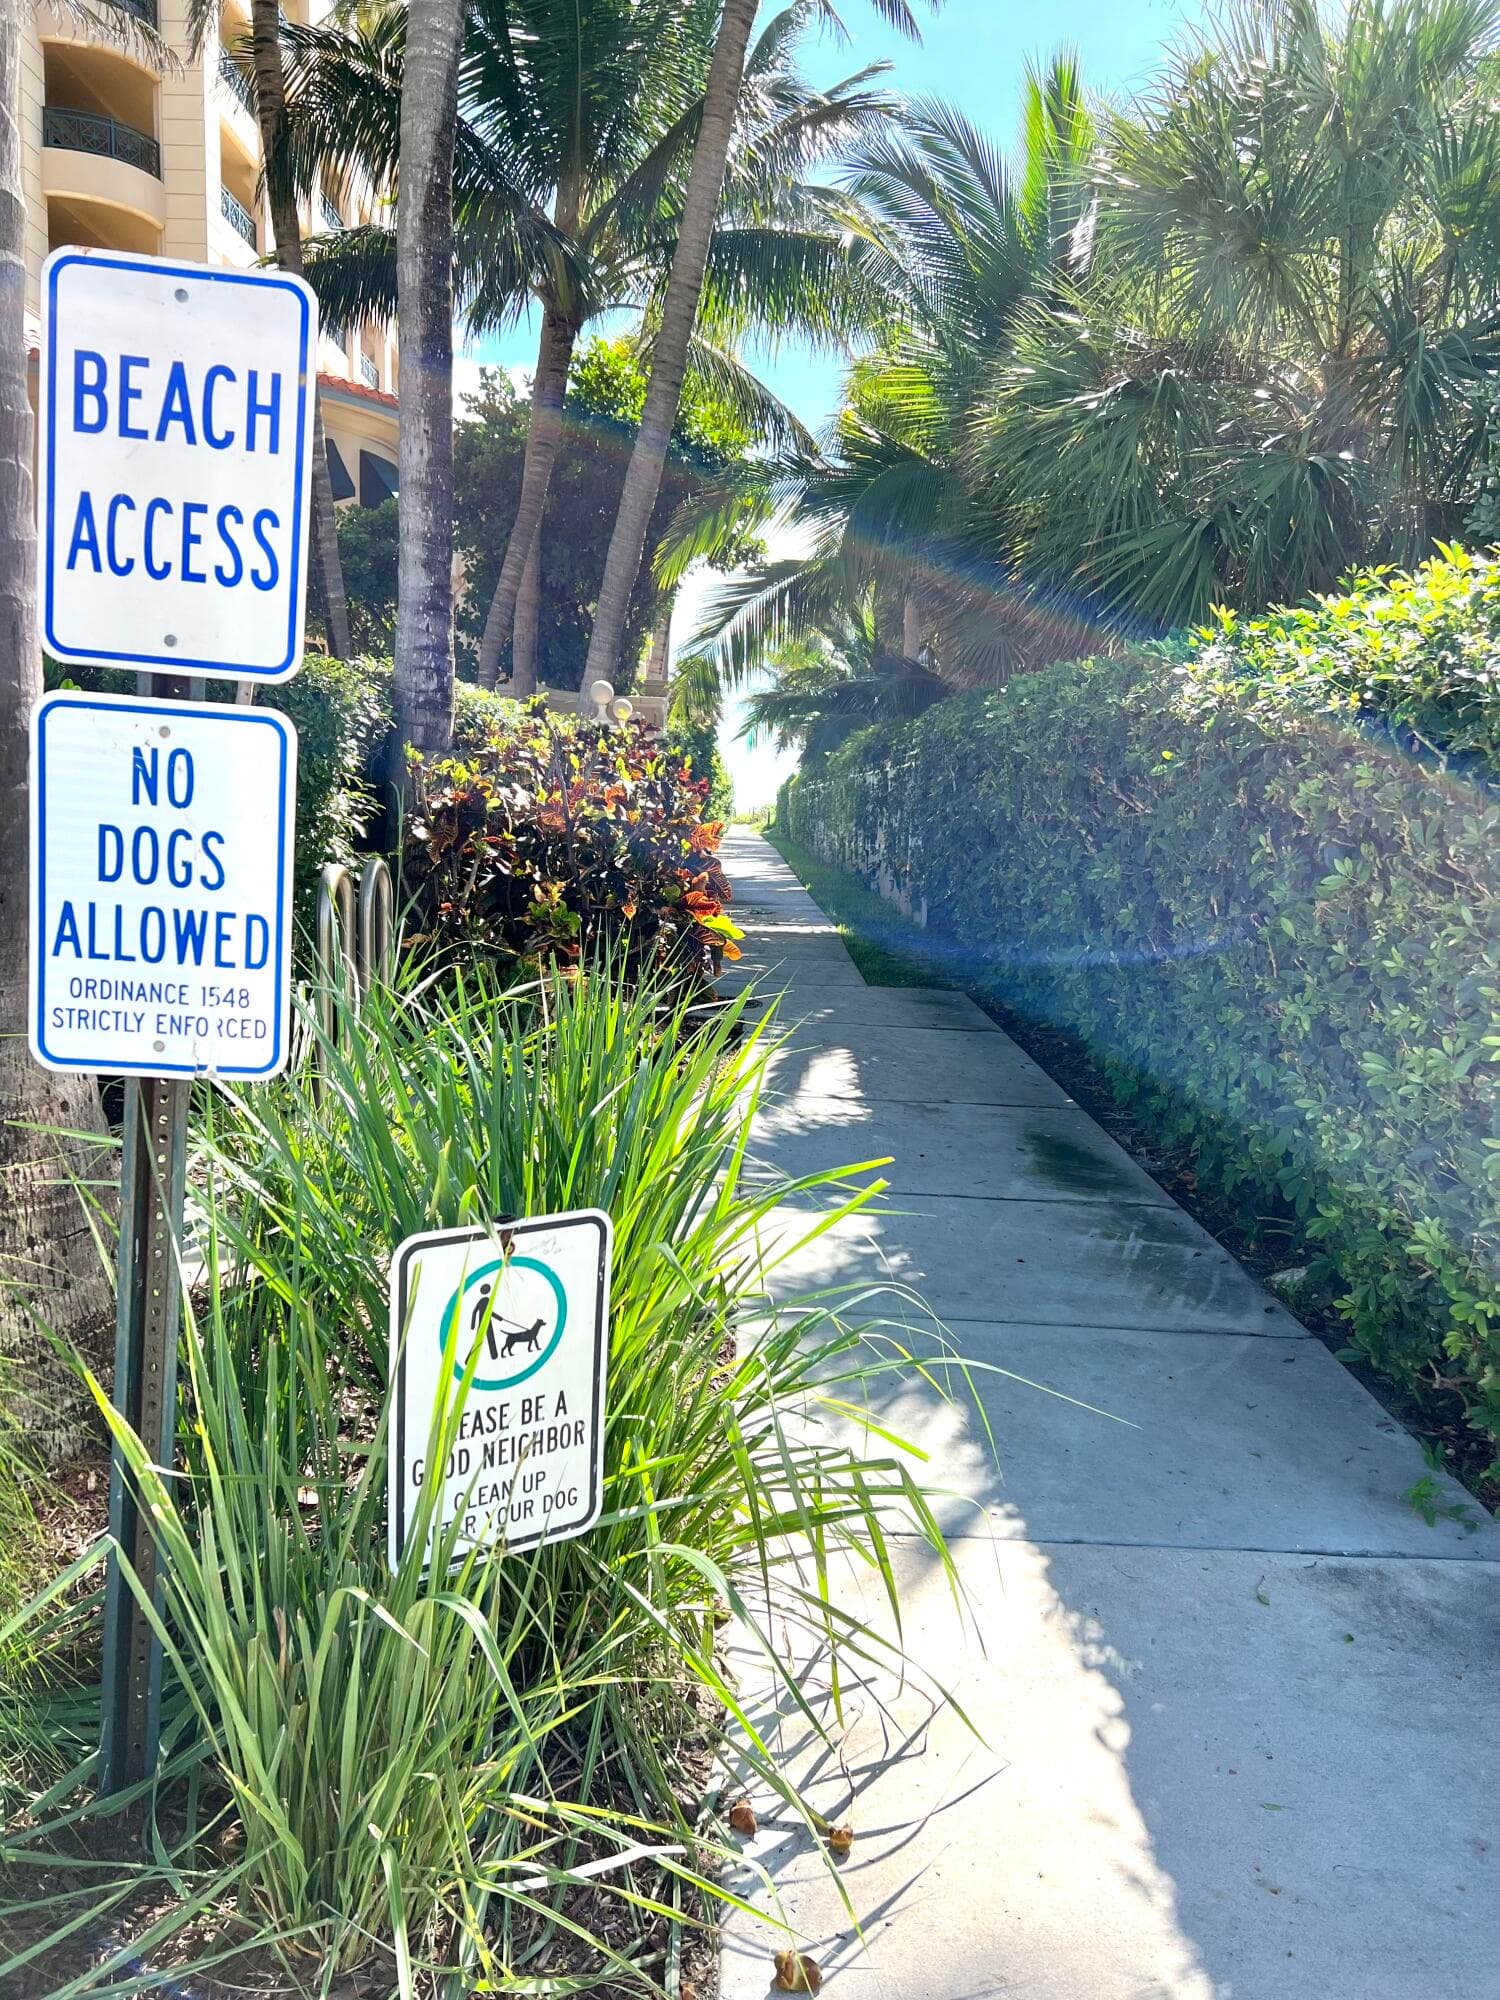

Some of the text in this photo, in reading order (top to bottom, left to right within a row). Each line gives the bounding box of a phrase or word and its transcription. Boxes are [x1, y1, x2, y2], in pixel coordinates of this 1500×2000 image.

[73, 349, 282, 454] BEACH
[66, 490, 280, 591] ACCESS
[132, 746, 195, 809] NO
[98, 823, 226, 891] DOGS
[52, 900, 271, 970] ALLOWED
[52, 1007, 146, 1033] STRICTLY
[69, 977, 251, 1009] ORDINANCE 1548
[447, 1389, 568, 1441] EASE BE A
[412, 1419, 585, 1487] GOD NEIGHBOR
[453, 1470, 546, 1511] CLEAN UP
[485, 1487, 578, 1530] YOUR DOG
